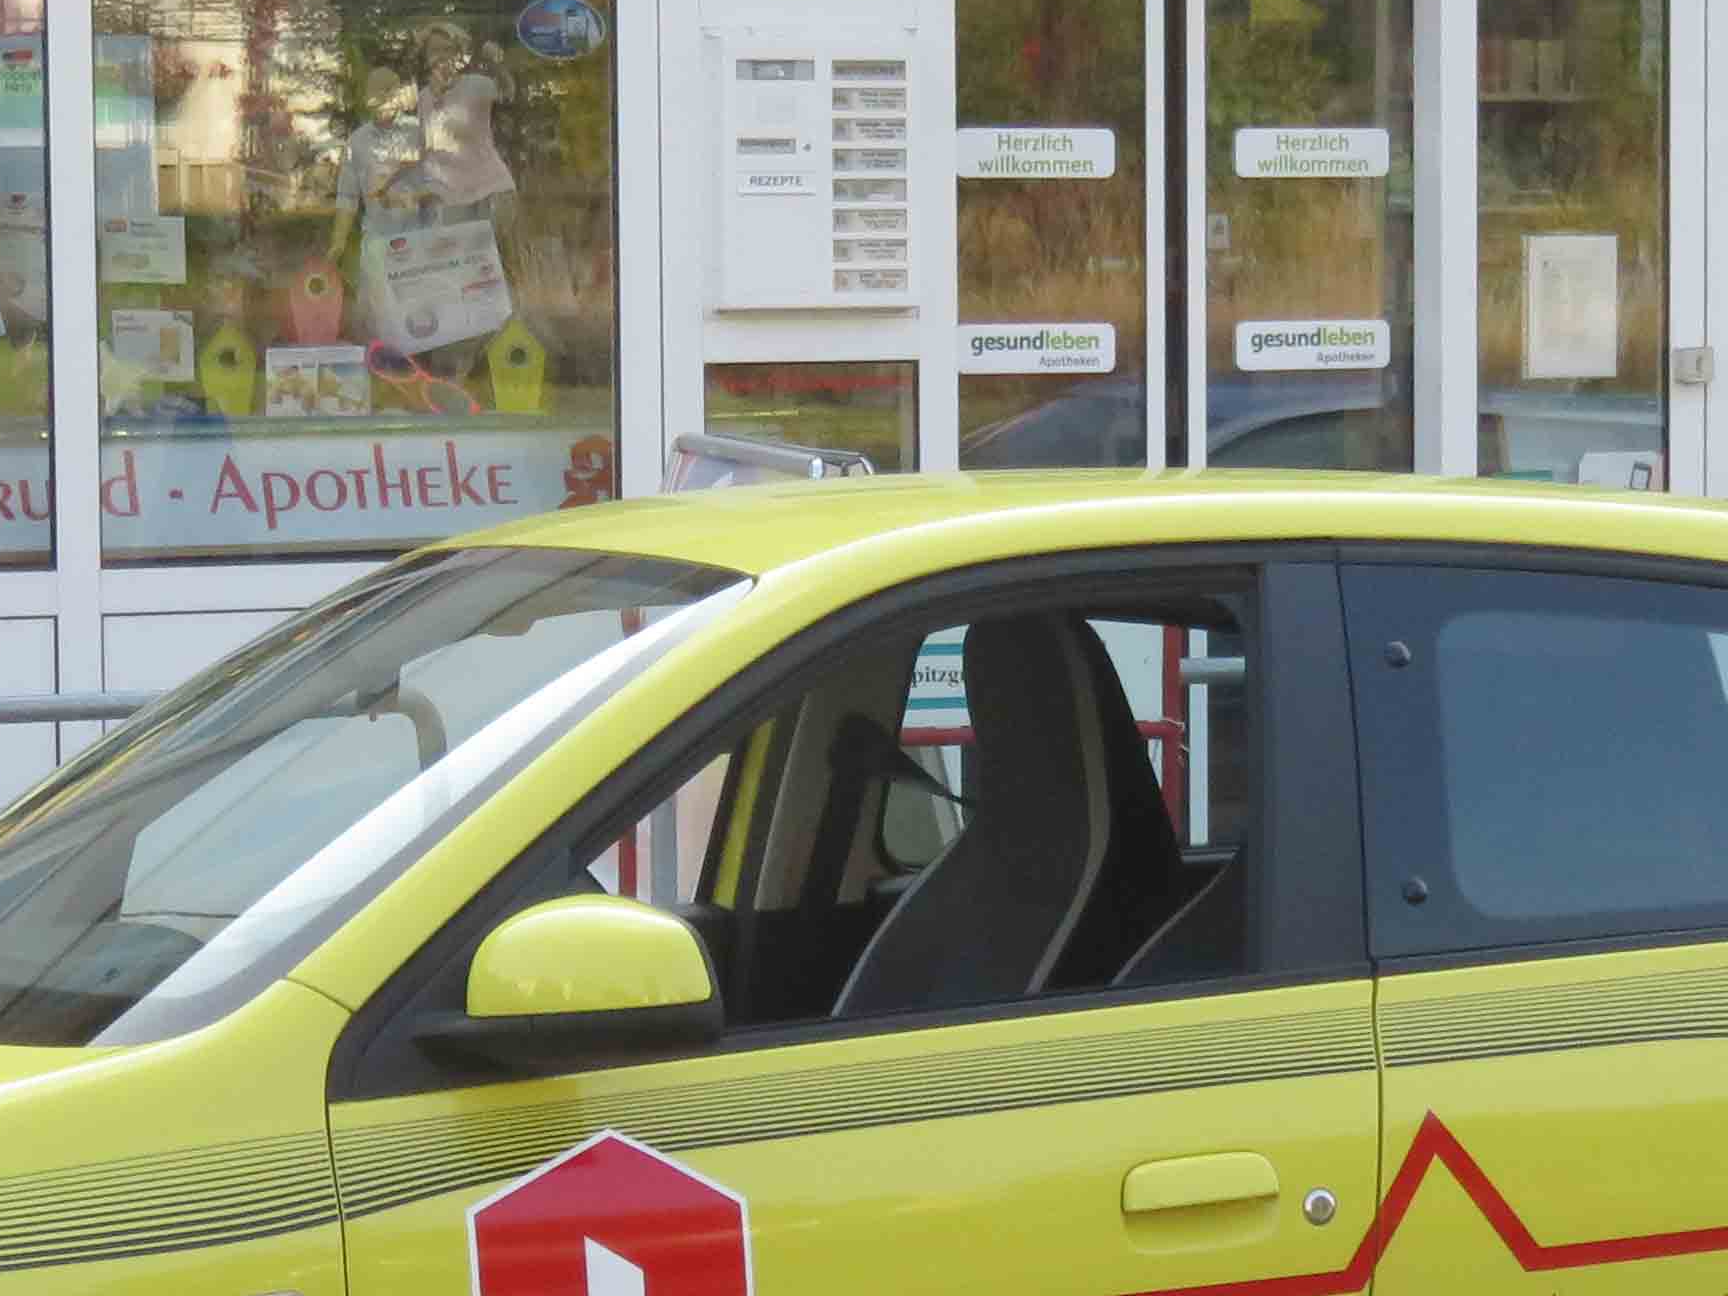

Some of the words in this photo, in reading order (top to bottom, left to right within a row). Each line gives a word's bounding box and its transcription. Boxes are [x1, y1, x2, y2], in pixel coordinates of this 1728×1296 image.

[997, 133, 1073, 153] Herzlich
[1275, 133, 1350, 153] Herzlich
[977, 155, 1095, 176] willkommen
[1256, 155, 1370, 175] willkommen
[749, 175, 804, 187] REZEPTE
[970, 330, 1100, 356] gesundleben
[1249, 326, 1375, 353] gesundleben
[1038, 356, 1100, 369] Apotheken
